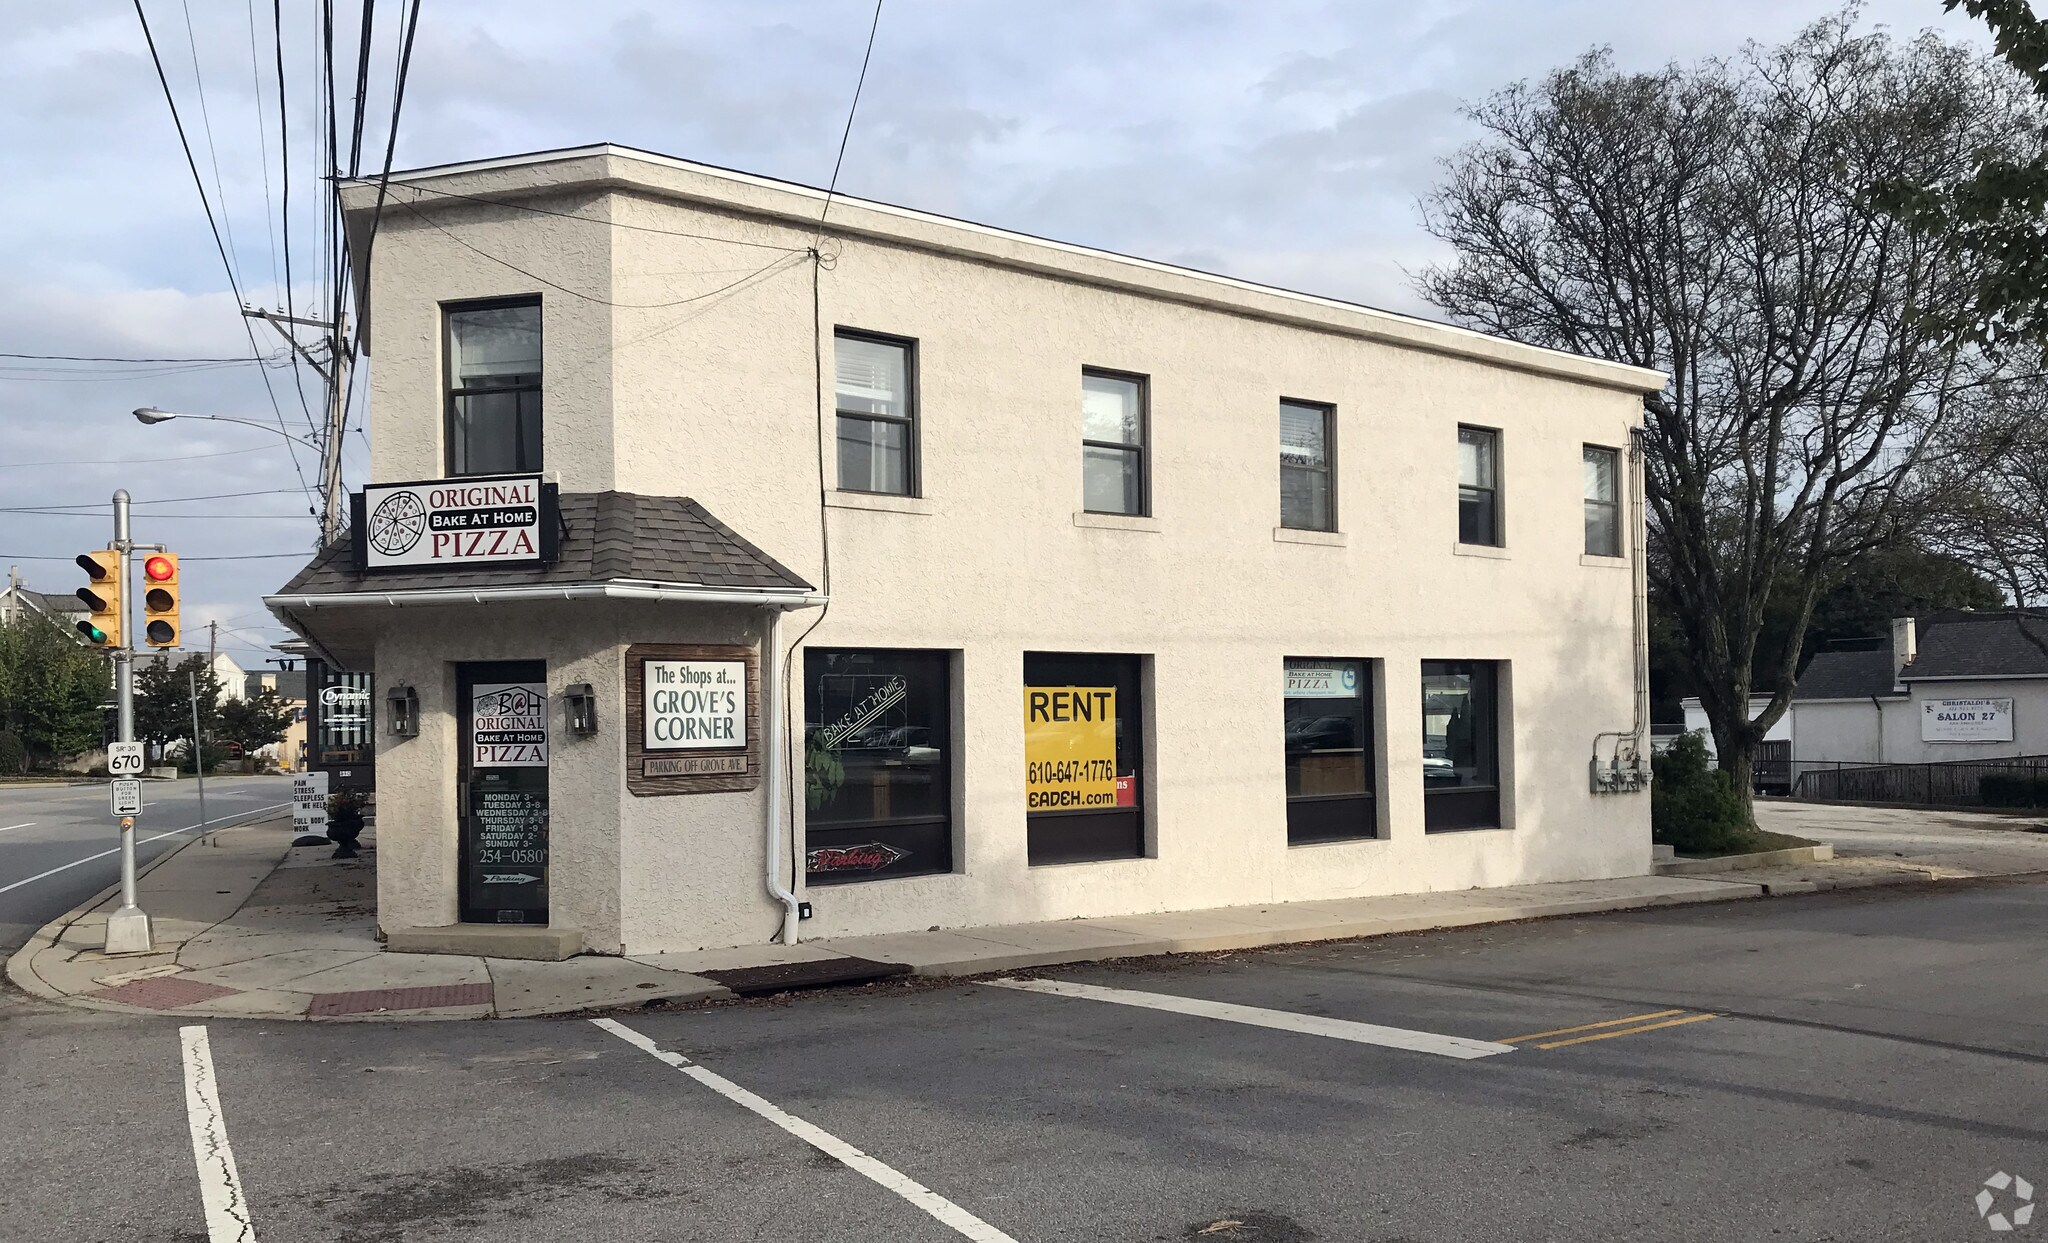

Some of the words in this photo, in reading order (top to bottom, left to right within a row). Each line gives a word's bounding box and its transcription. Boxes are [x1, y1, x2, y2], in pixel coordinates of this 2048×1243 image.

[429, 485, 536, 509] ORIGINAL
[432, 515, 467, 527] BAKE
[471, 514, 489, 525] AT
[493, 511, 533, 524] HOME
[430, 529, 536, 559] PIZZA
[655, 665, 676, 684] The
[679, 666, 712, 688] Shops
[716, 668, 736, 684] at...
[1288, 679, 1329, 689] PIZZA
[325, 690, 370, 703] Dynamic
[653, 690, 736, 714] GROVE'S
[823, 712, 853, 742] BAKE
[853, 698, 869, 719] AT
[868, 676, 902, 706] HOME
[1030, 691, 1112, 723] RENT
[475, 717, 544, 730] ORIGINAL
[1937, 712, 1976, 721] SALON
[1981, 712, 1996, 721] 27
[654, 717, 735, 741] CORNER
[477, 734, 500, 742] BAKE
[476, 745, 544, 762] PIZZA
[112, 755, 141, 770] 670
[650, 760, 682, 773] PARKING
[684, 760, 699, 772] OFF
[700, 759, 725, 771] GROVE
[728, 759, 743, 770] AVE.
[1029, 760, 1113, 784] 610-647-1776
[293, 794, 325, 802] SLEEPLESS
[1028, 791, 1114, 808] EADEH.com
[476, 809, 530, 817] WEDNESDAY
[293, 817, 308, 825] FULL
[480, 817, 526, 825] THURSDAY
[480, 832, 525, 840] SATURDAY
[479, 850, 544, 863] 254-0580
